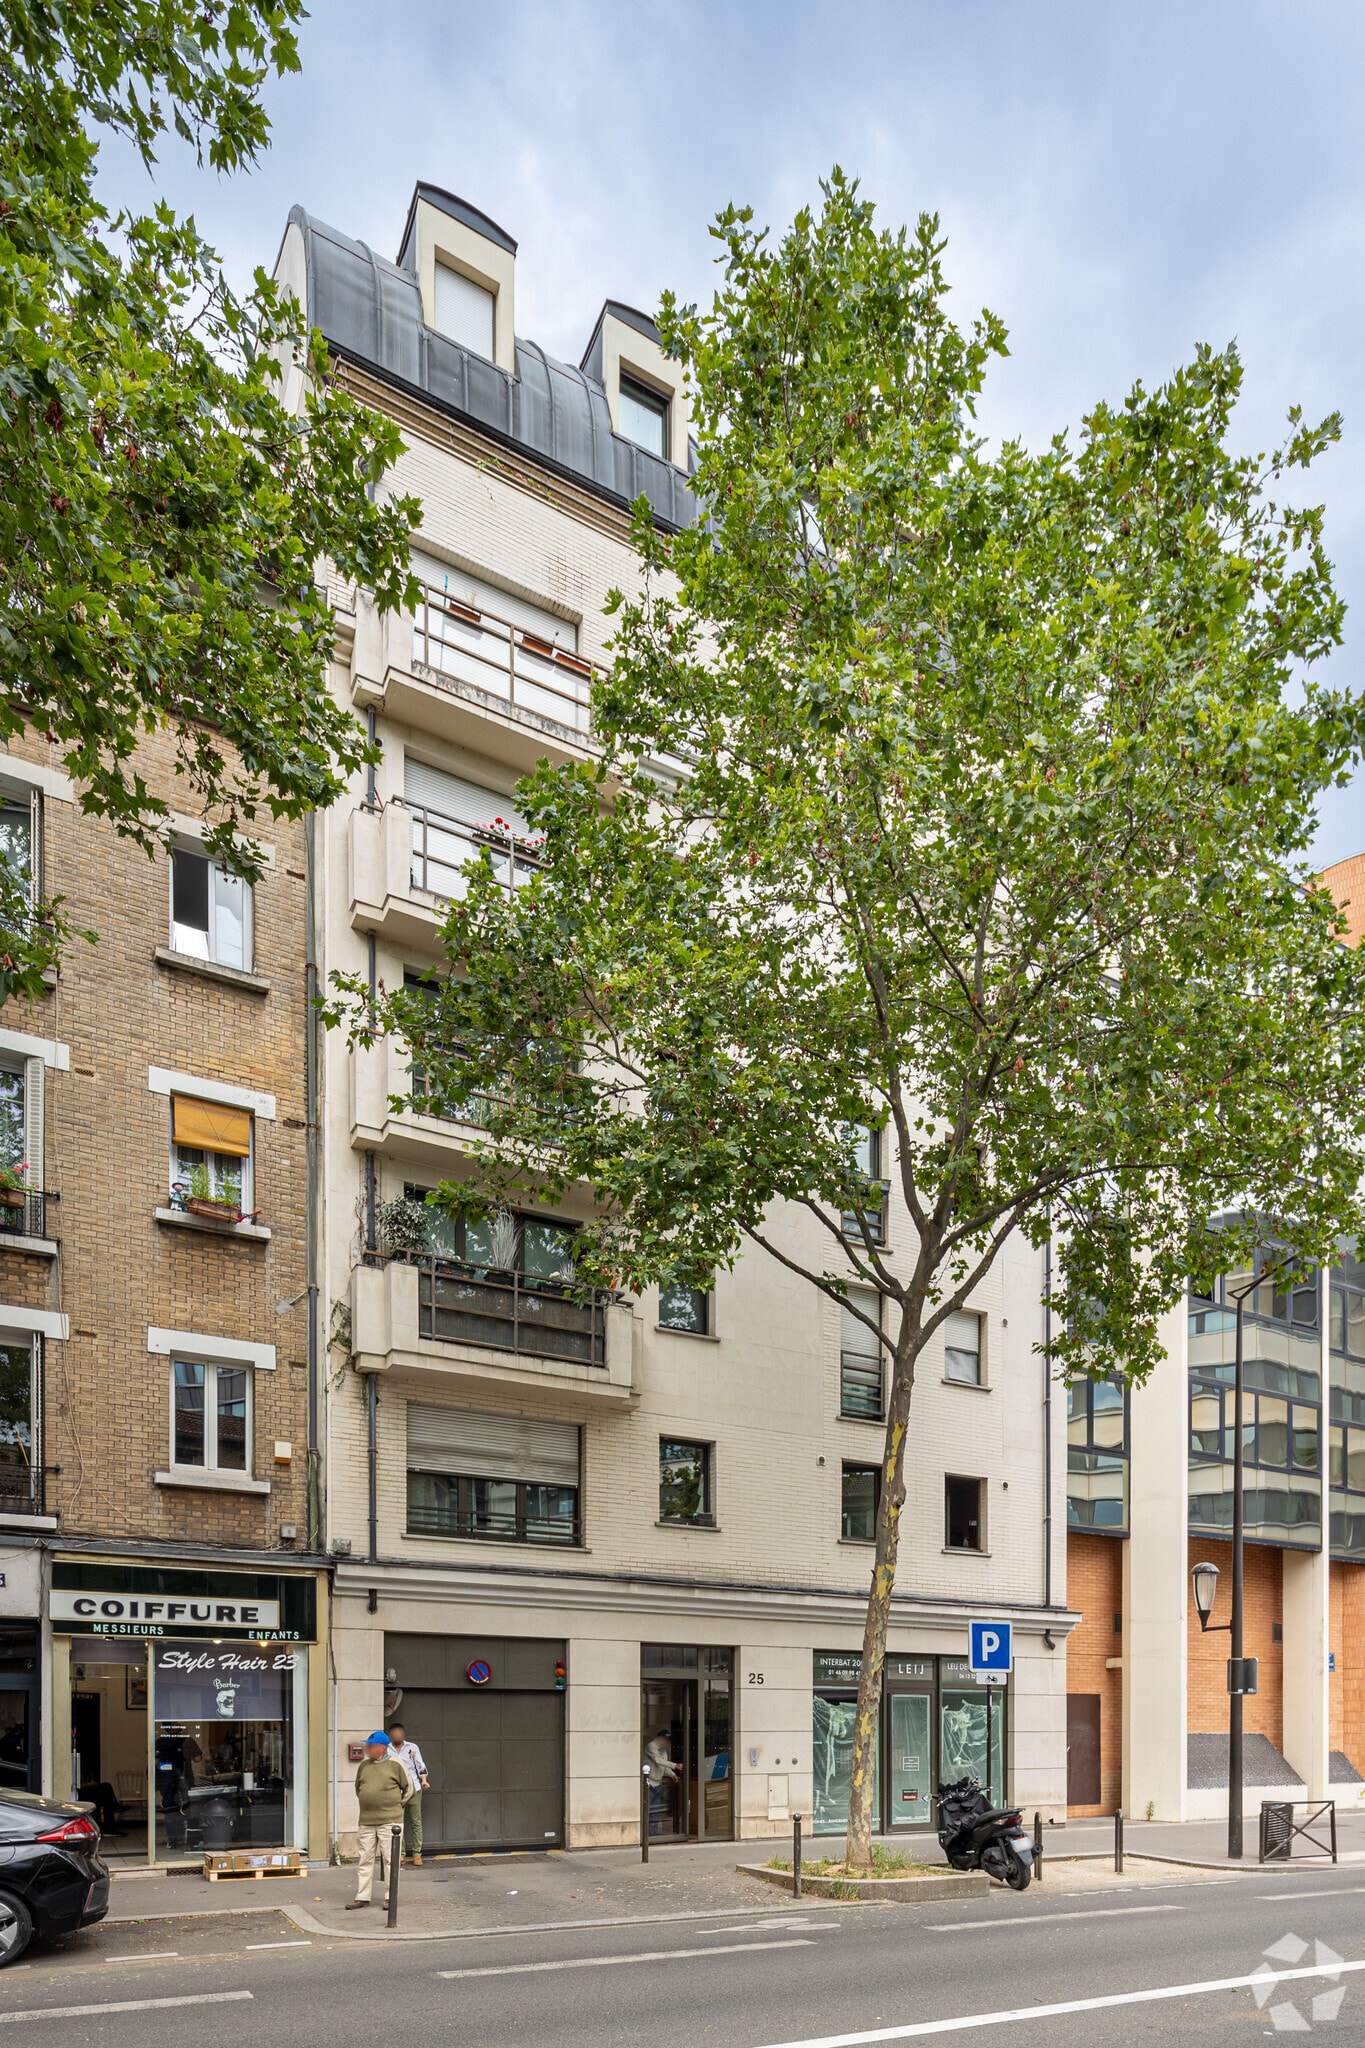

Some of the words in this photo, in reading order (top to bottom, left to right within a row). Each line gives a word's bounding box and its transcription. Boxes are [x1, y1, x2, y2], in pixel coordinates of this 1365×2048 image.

[73, 1598, 259, 1623] COIFFURE
[93, 1623, 165, 1635] MESSIEURS
[248, 1630, 300, 1640] ENFANTS
[981, 1631, 1000, 1662] P
[158, 1651, 216, 1674] Style
[218, 1653, 269, 1670] Hair
[272, 1654, 300, 1670] 23
[819, 1657, 851, 1666] INTERBAT
[898, 1663, 924, 1675] LEIJ
[212, 1677, 241, 1690] Barber
[748, 1672, 765, 1685] 25
